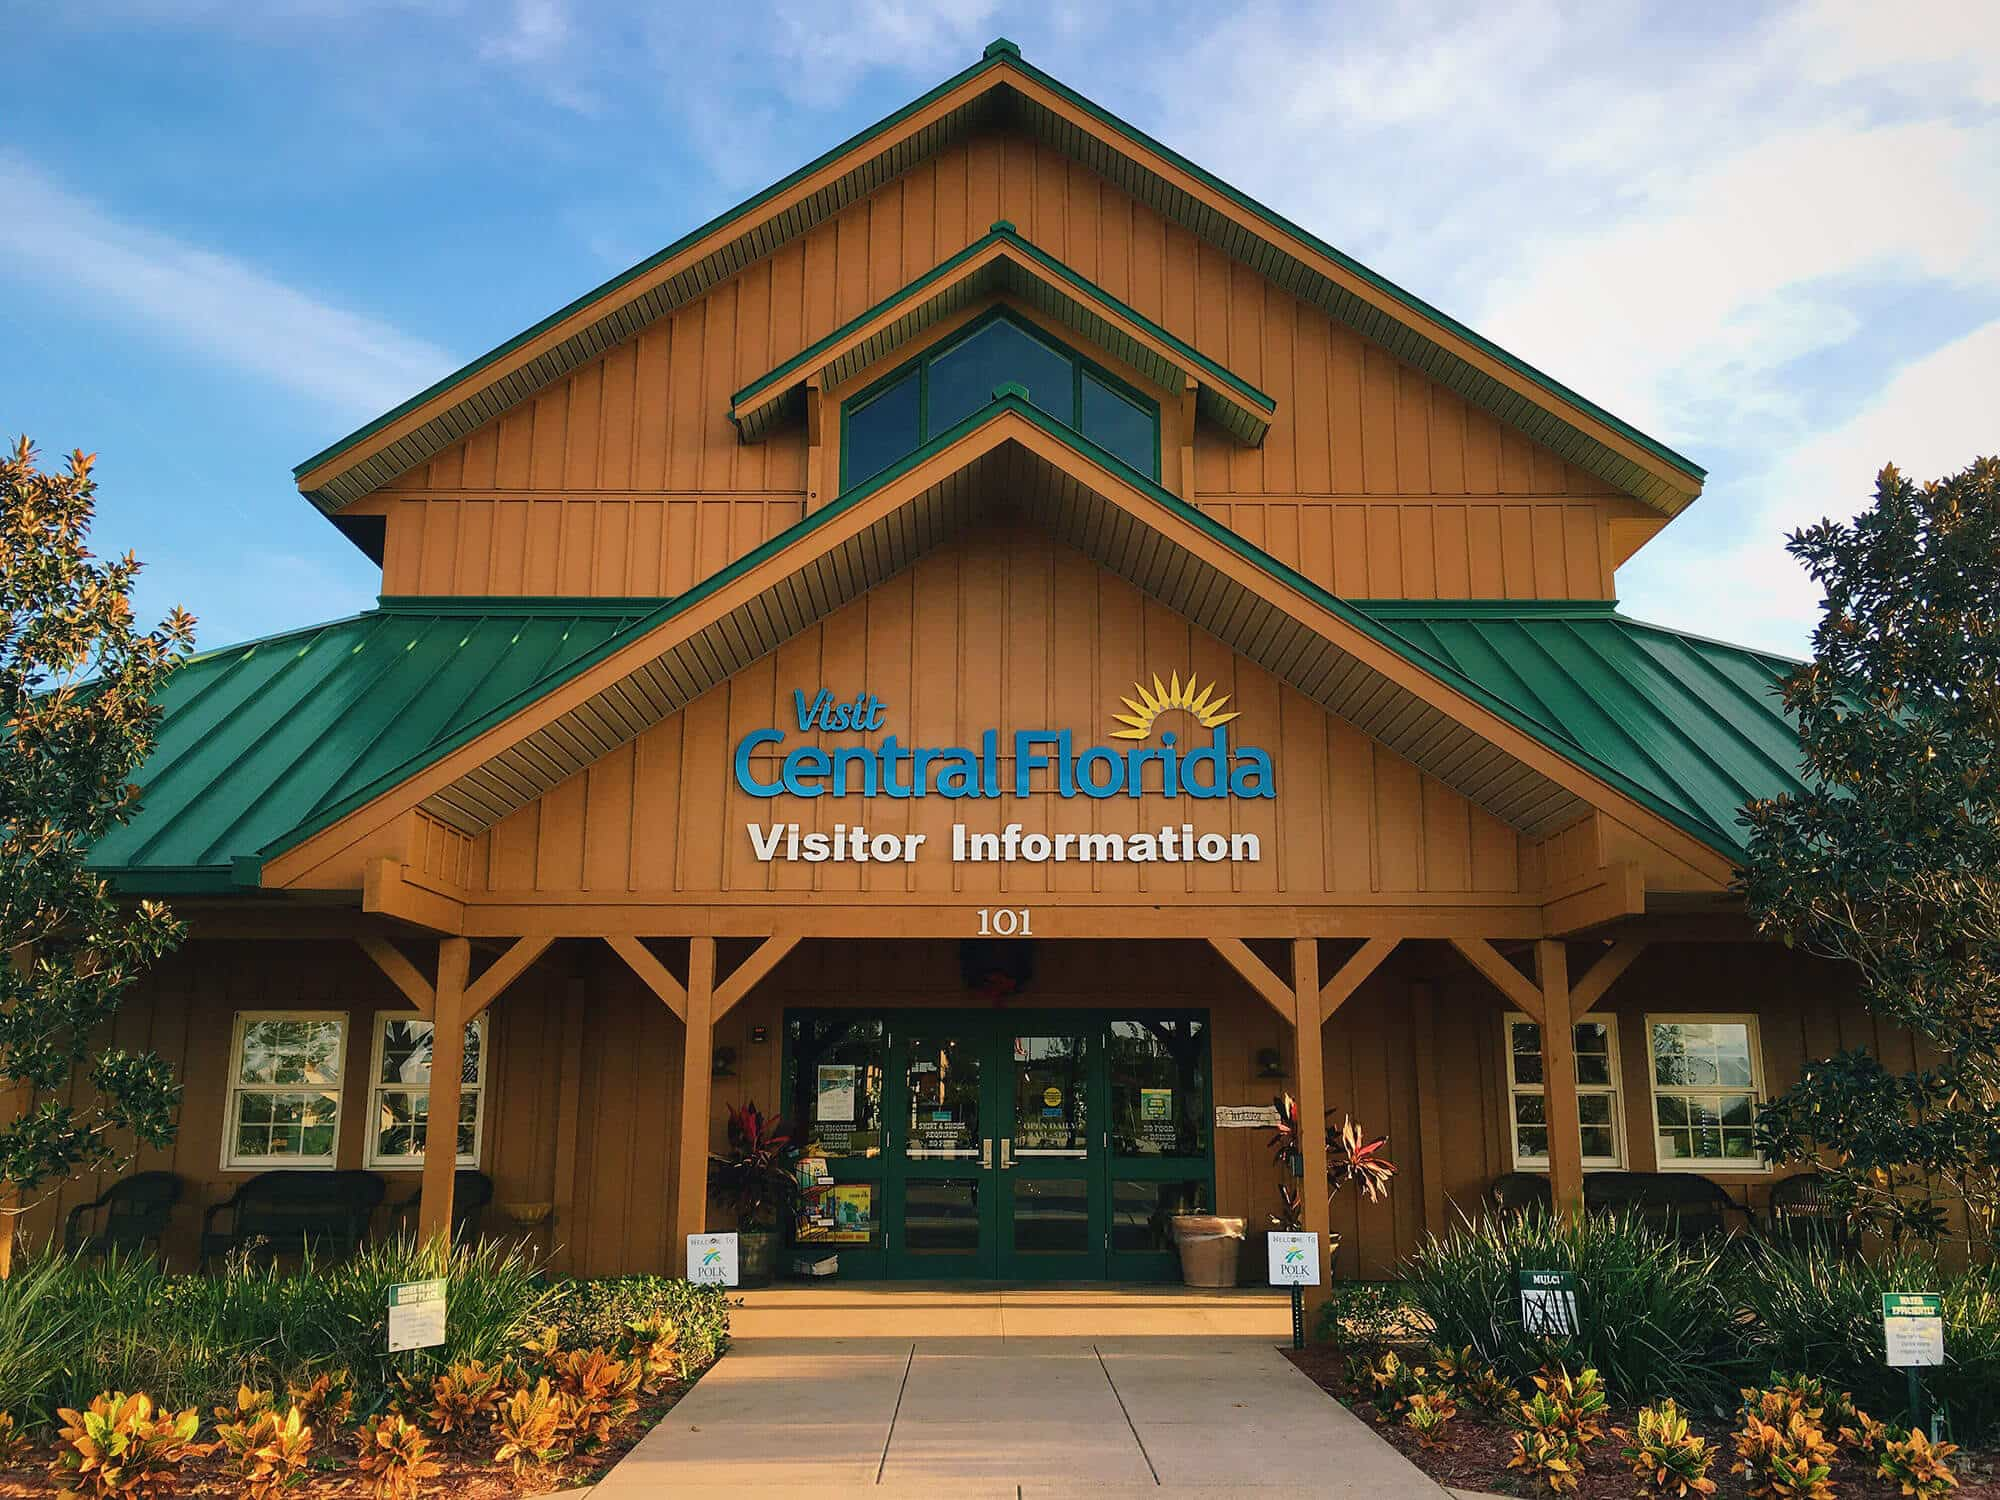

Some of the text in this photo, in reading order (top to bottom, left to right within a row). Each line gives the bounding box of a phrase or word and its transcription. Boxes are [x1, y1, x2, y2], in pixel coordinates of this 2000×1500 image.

[793, 687, 889, 732] Visit
[735, 724, 1277, 799] Central Florida
[746, 823, 1262, 863] Visitor Information
[976, 908, 1033, 937] 101
[698, 1266, 727, 1278] POLK
[1280, 1264, 1310, 1276] POLK
